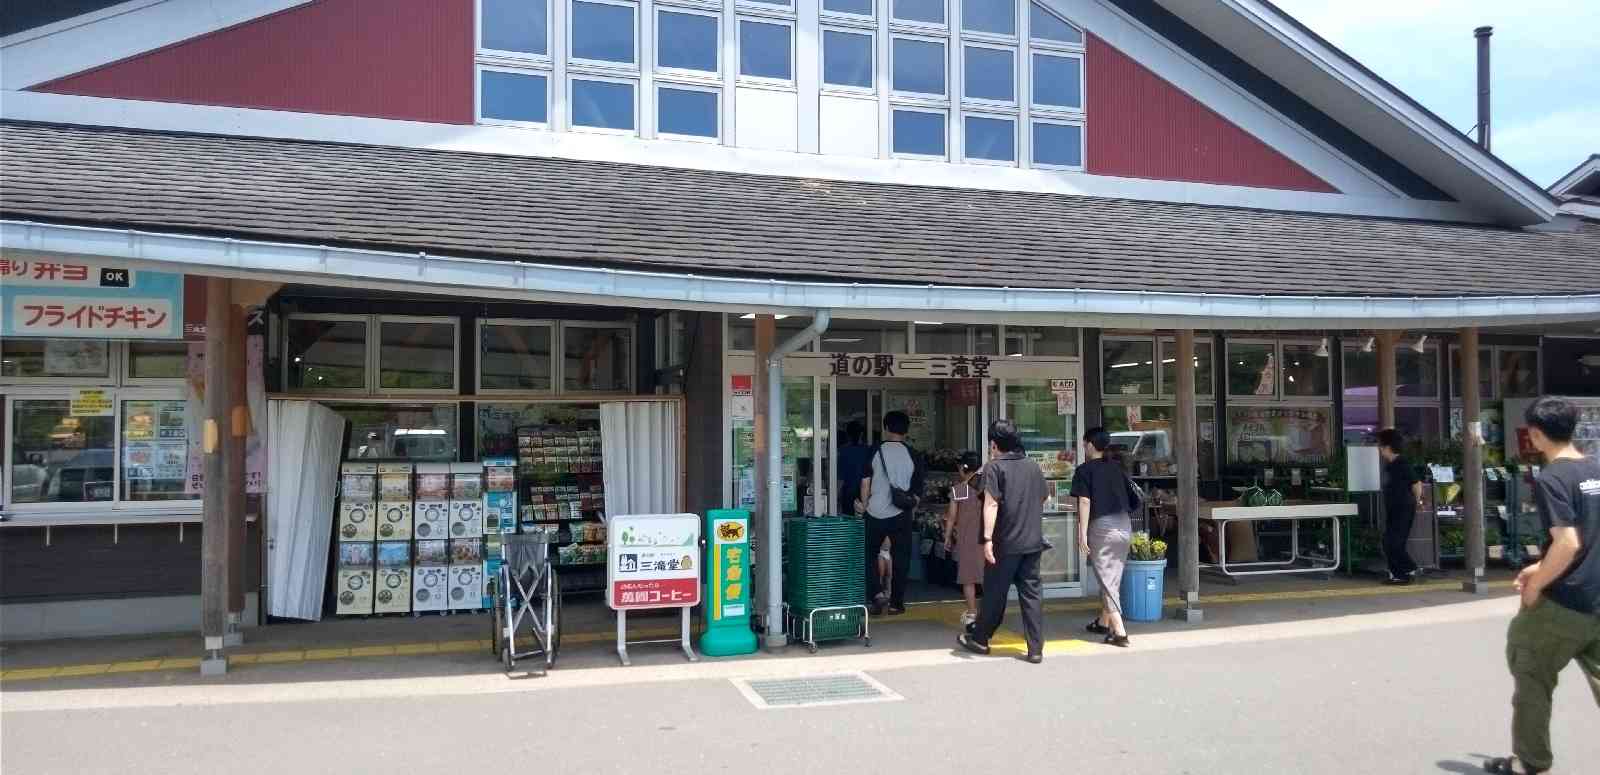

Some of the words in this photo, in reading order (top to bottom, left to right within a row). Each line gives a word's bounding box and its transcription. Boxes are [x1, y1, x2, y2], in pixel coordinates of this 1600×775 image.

[105, 271, 125, 281] OK
[23, 305, 167, 329] フライドチキン
[830, 352, 895, 377] 道の駅
[929, 355, 991, 378] 三滝堂
[640, 558, 680, 571] 三滝堂
